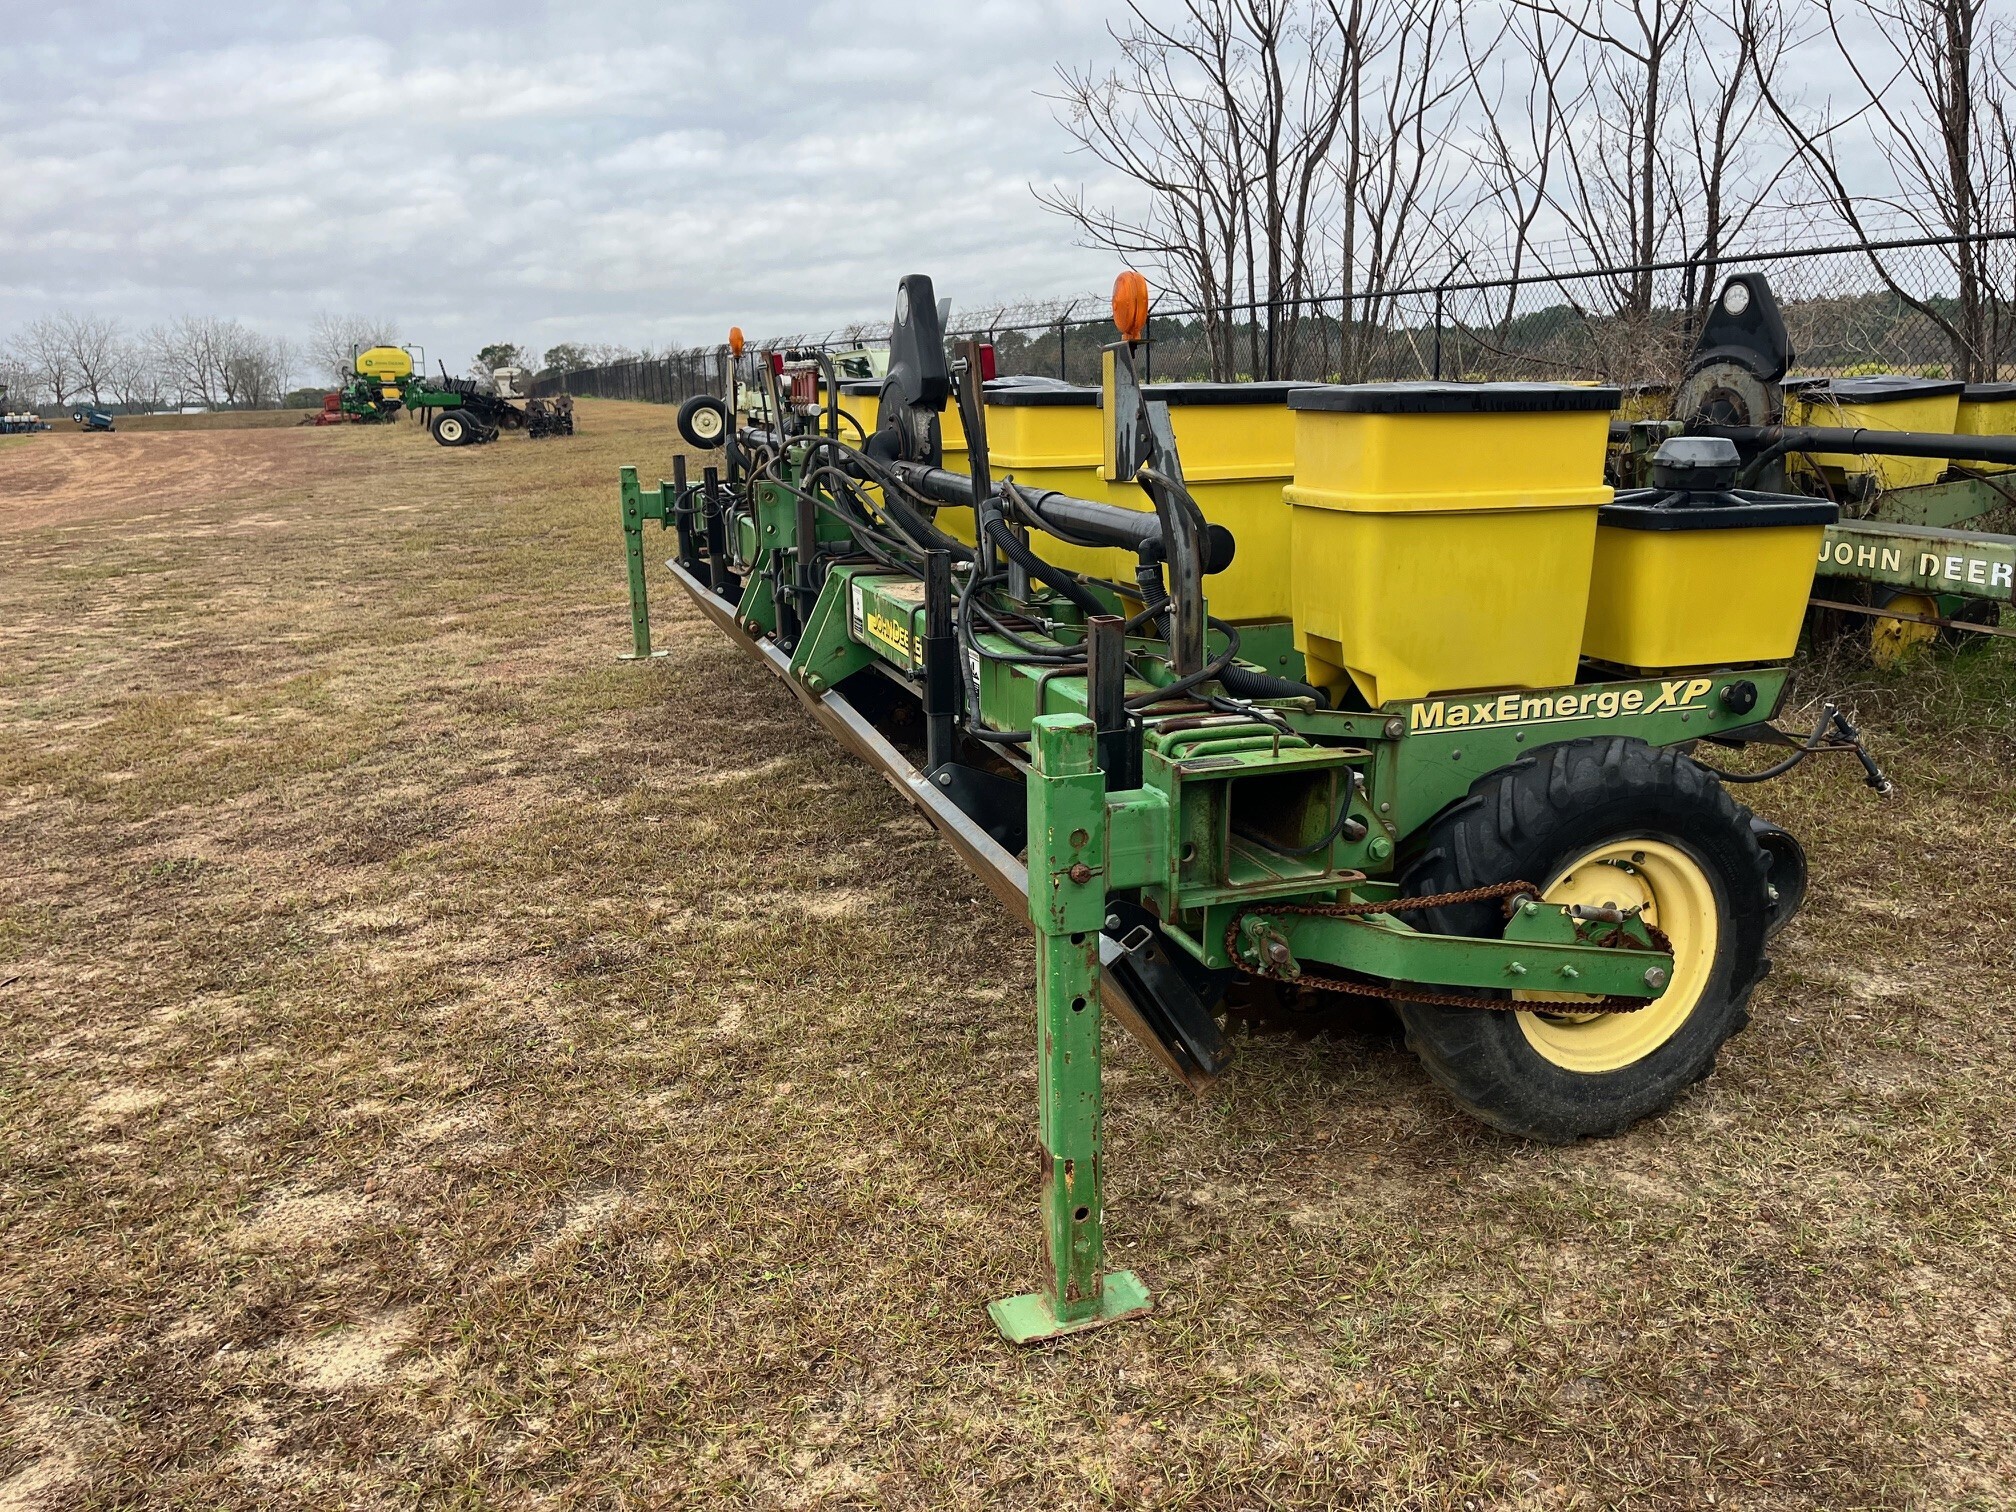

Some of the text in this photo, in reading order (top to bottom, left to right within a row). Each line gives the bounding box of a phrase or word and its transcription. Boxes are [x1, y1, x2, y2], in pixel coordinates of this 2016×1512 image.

[1817, 540, 1901, 572] JOHN
[892, 618, 922, 658] DEEE
[1410, 678, 1713, 730] MaxEmerge XP
